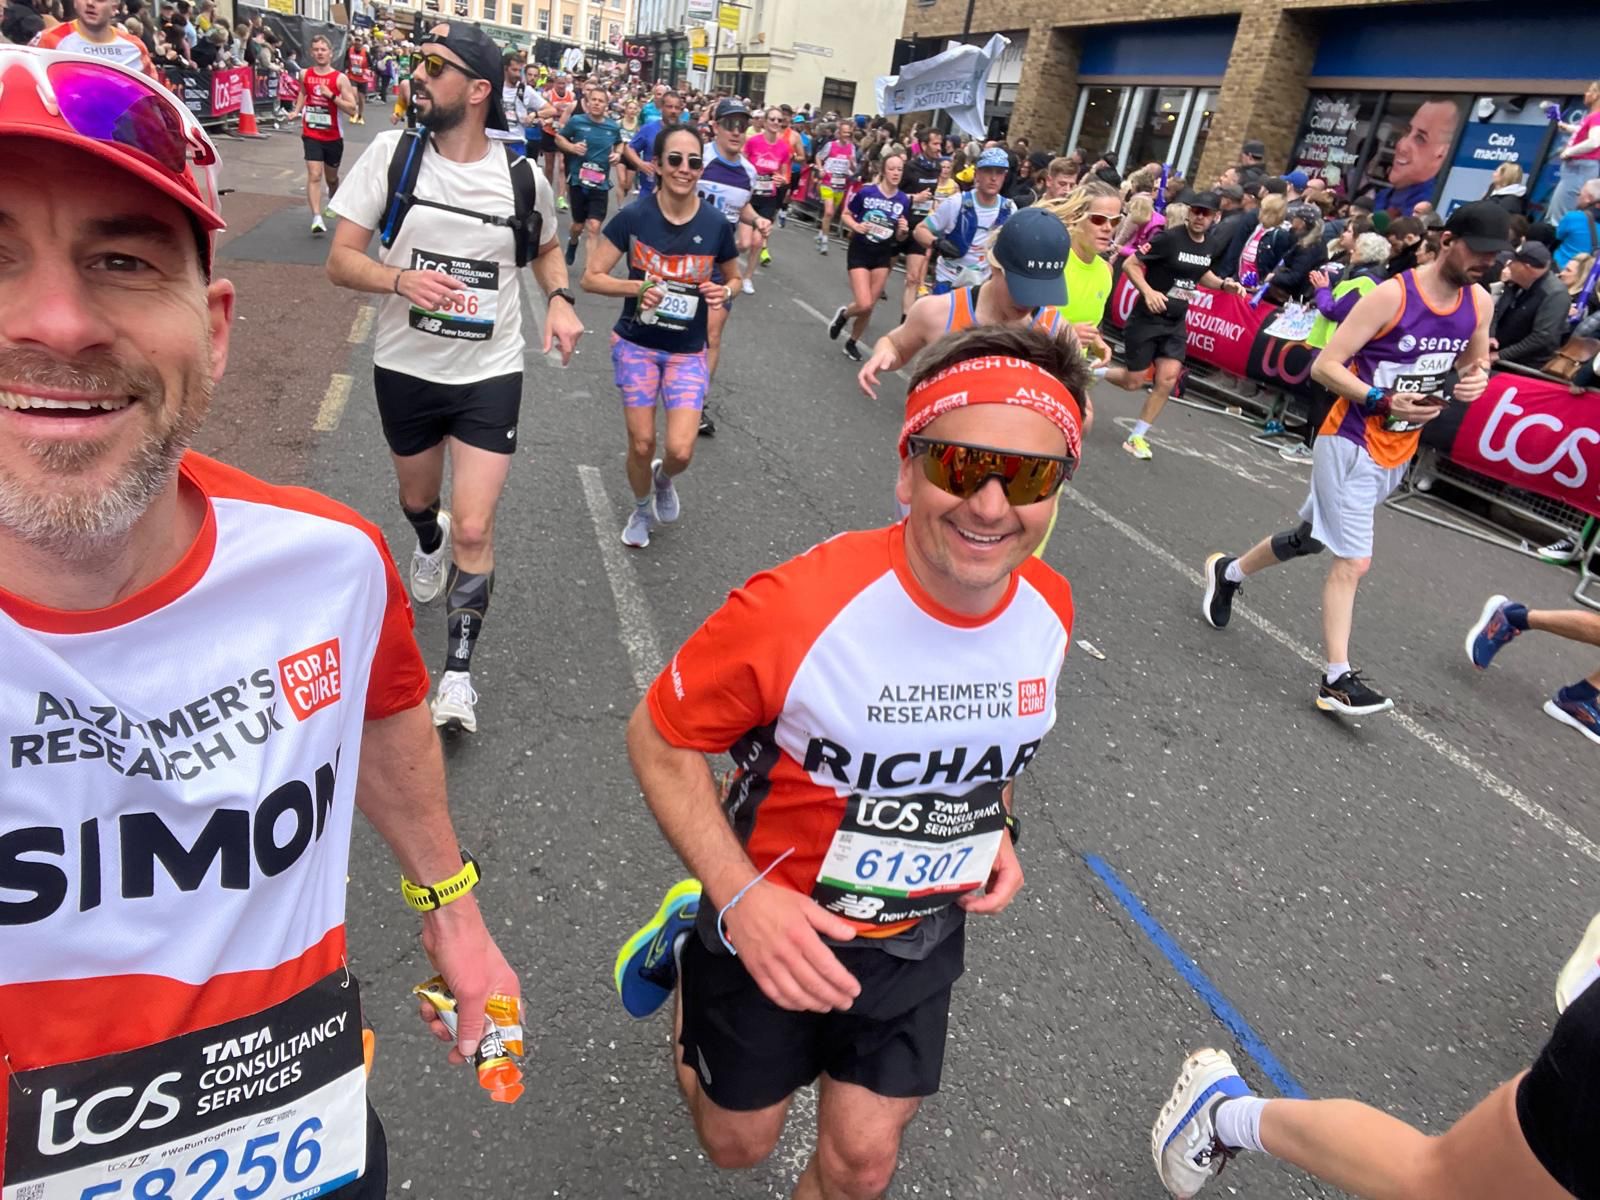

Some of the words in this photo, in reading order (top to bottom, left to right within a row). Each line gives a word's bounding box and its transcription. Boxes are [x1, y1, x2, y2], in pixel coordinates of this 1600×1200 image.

[83, 47, 122, 55] CHUBB
[625, 41, 646, 57] tcs
[1315, 99, 1350, 116] Serving
[1310, 116, 1335, 132] Cutty
[1336, 117, 1359, 131] Sark
[1305, 132, 1347, 147] shoppers
[1488, 133, 1515, 146] Cash
[1306, 147, 1327, 161] little
[1473, 148, 1519, 162] machine
[863, 197, 893, 212] SOPHIE
[450, 268, 494, 279] CONSULTANCY
[451, 261, 471, 269] TATA
[660, 296, 688, 314] 293
[1188, 291, 1214, 310] TA
[441, 328, 457, 337] new
[1186, 312, 1245, 342] NSULTANCY
[1186, 330, 1215, 352] VICES
[1262, 337, 1312, 384] tc
[1419, 359, 1448, 371] SAM
[1396, 377, 1420, 393] tcs
[1478, 386, 1600, 488] tcs
[283, 654, 322, 687] FOR
[323, 647, 338, 669] A
[294, 671, 340, 712] CURE
[879, 682, 1013, 702] ALZHEIMER'S
[1020, 683, 1035, 699] FOR
[1036, 682, 1044, 697] A
[35, 668, 275, 749] ALZHMER'S
[867, 704, 986, 723] RESEARCH
[987, 702, 1012, 718] UK
[1020, 697, 1044, 715] CURE
[234, 702, 284, 745] UK
[856, 797, 923, 832] tcs
[934, 800, 968, 814] TATA
[924, 821, 975, 837] SERVICES
[855, 846, 973, 885] 61307
[879, 910, 907, 922] new
[199, 1011, 348, 1091] CONSULTANCY
[202, 1026, 273, 1065] TATA
[196, 1061, 302, 1116] SERVICES
[37, 1071, 182, 1156] tcs
[160, 1124, 247, 1159] #WeRunTogether
